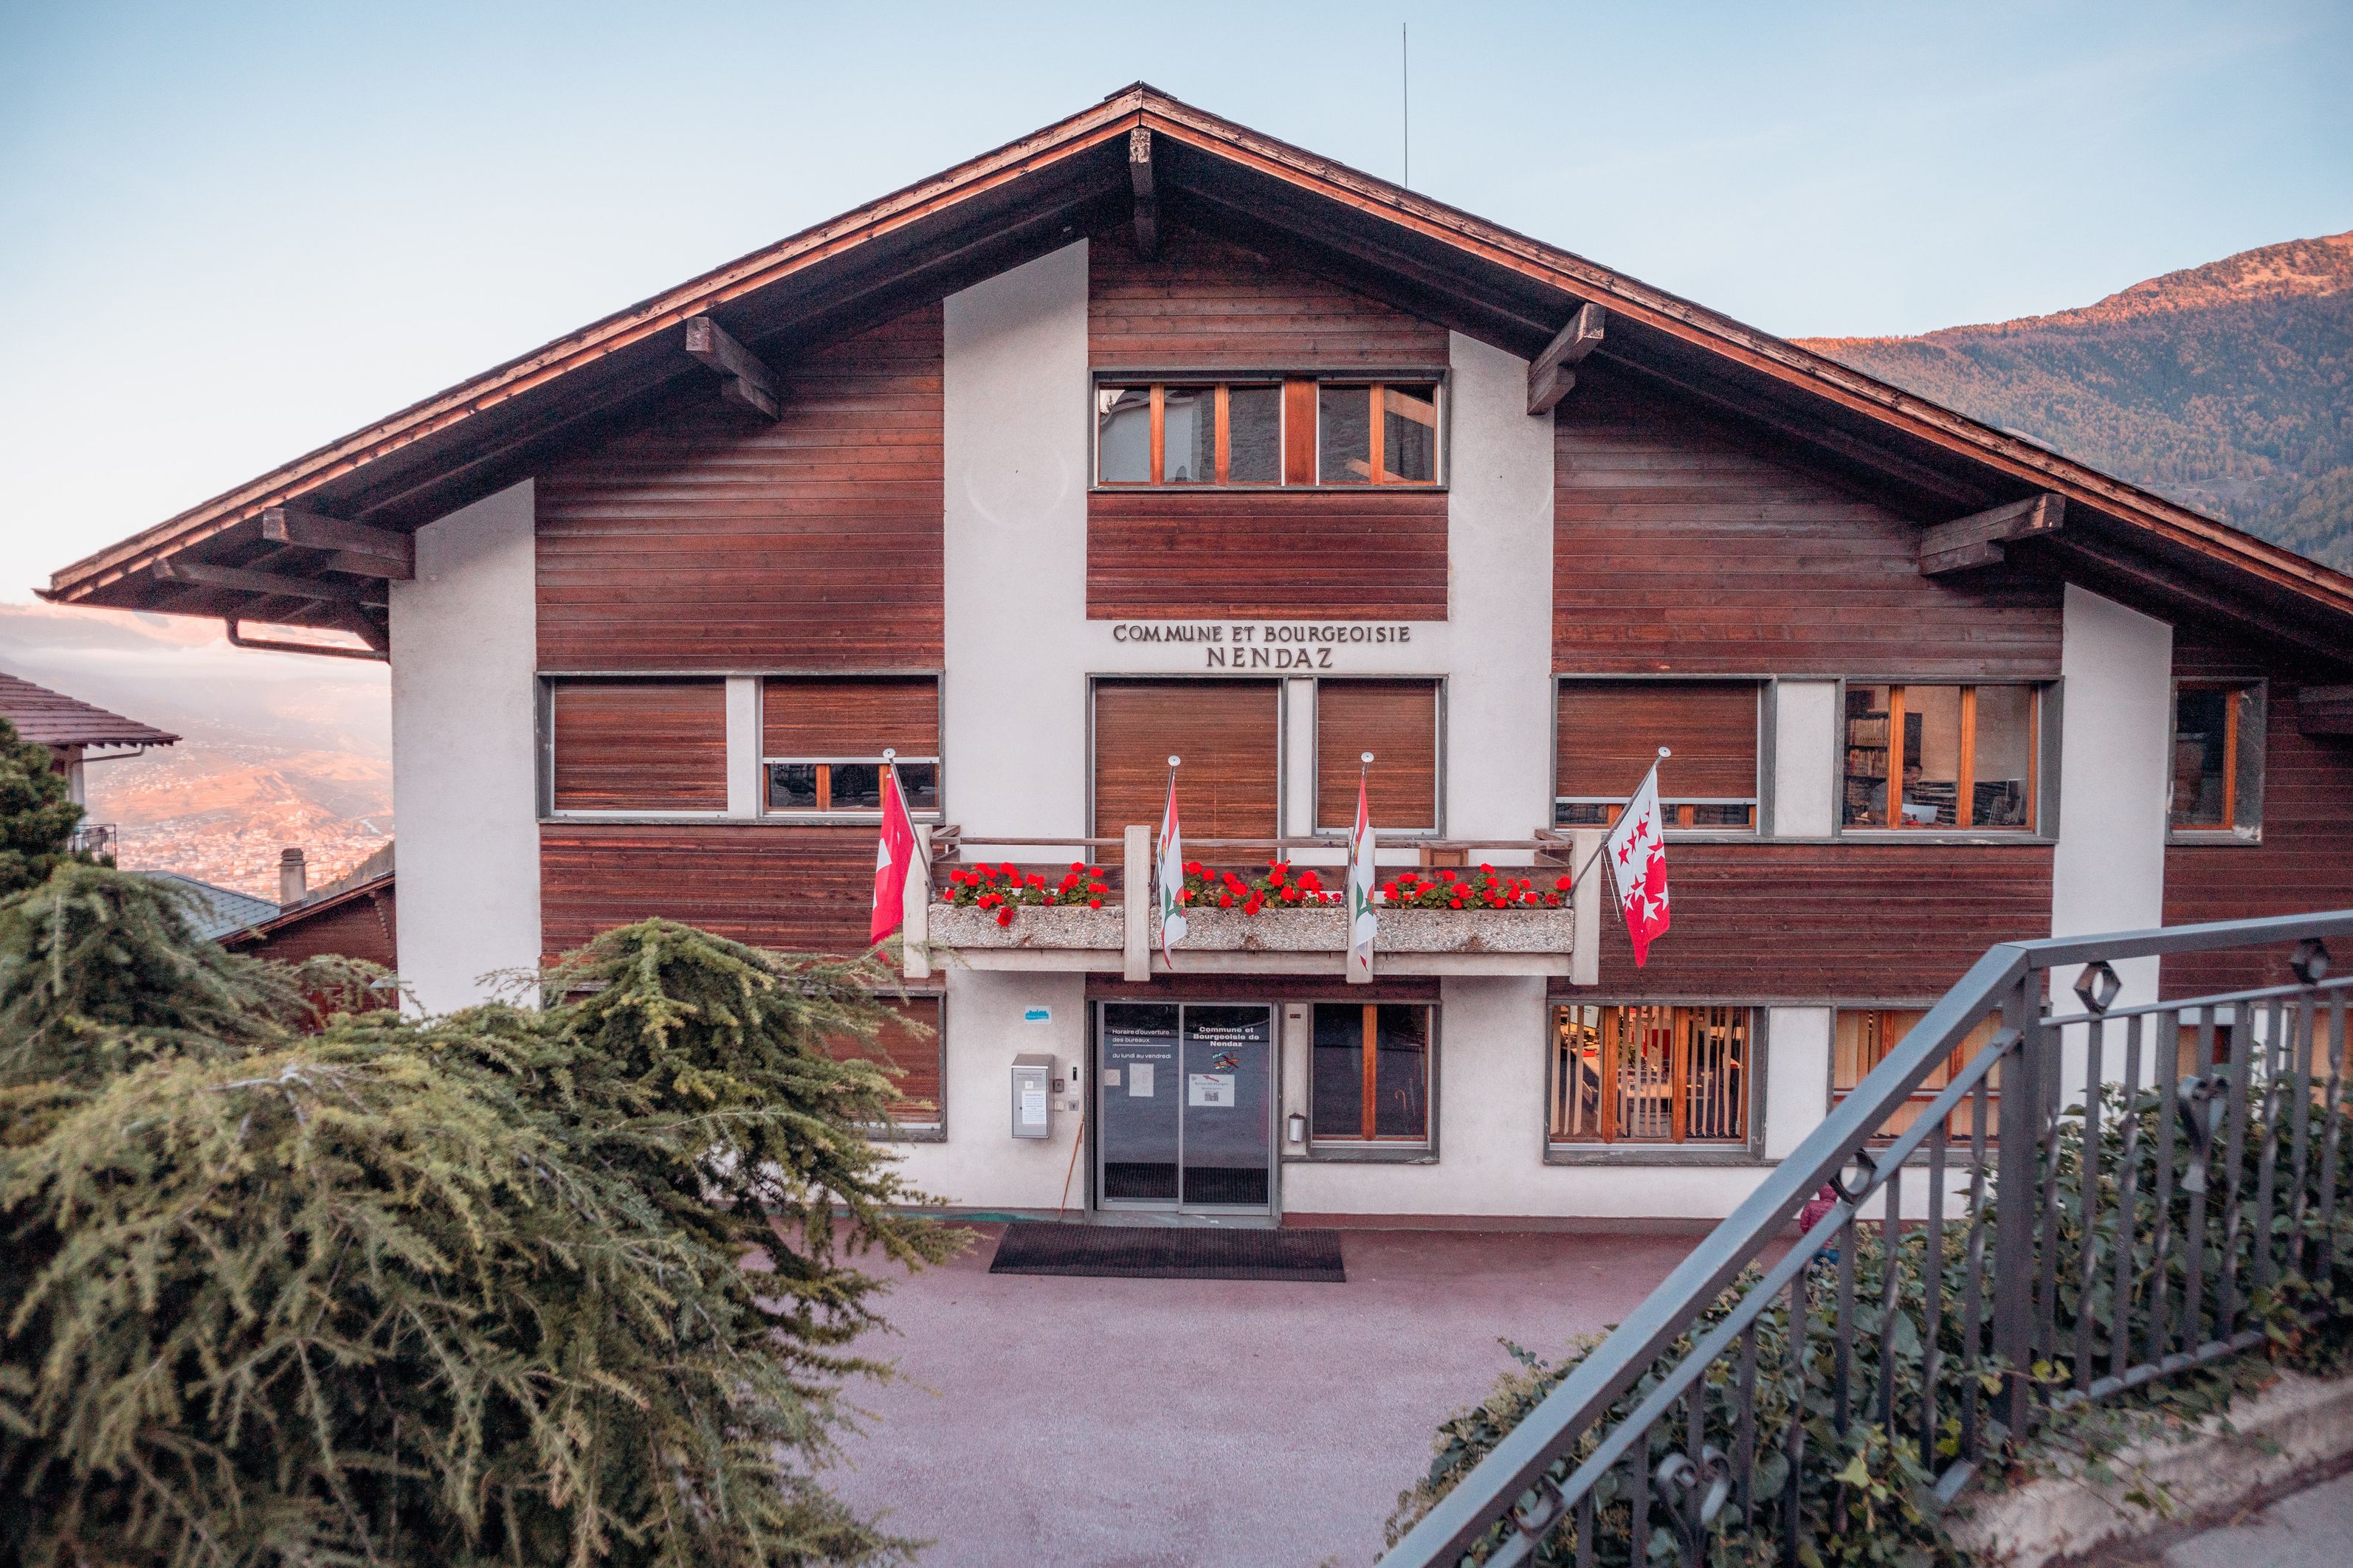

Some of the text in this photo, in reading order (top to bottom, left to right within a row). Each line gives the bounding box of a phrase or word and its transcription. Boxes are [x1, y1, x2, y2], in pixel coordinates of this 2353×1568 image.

[1113, 624, 1410, 643] COMMUNE ET BOURGEOISIE
[1207, 647, 1333, 668] NENDAZ
